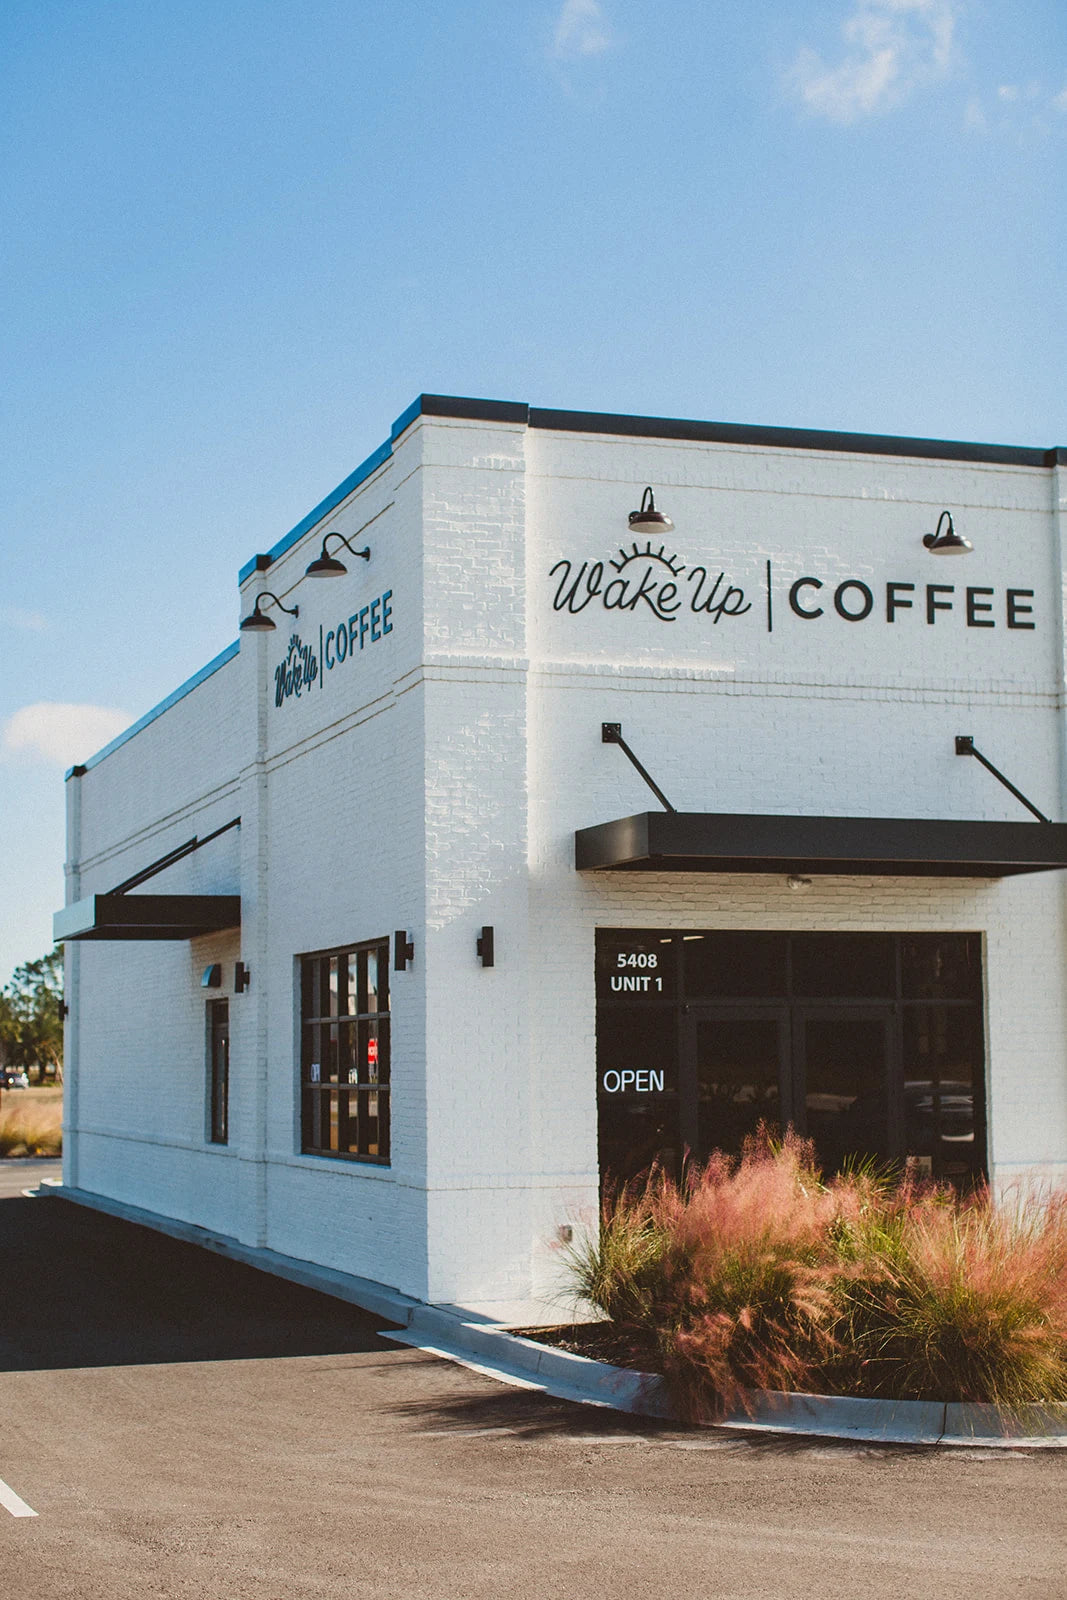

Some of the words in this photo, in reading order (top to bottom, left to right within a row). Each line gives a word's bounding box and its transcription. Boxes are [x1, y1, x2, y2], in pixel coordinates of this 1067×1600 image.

[549, 559, 682, 621] Wake
[687, 567, 752, 624] Up
[789, 576, 1036, 630] COFFEE
[325, 589, 394, 670] COFFEE
[617, 953, 658, 969] 5408
[610, 976, 651, 992] UNIT
[655, 976, 664, 992] 1
[603, 1069, 665, 1093] OPEN
